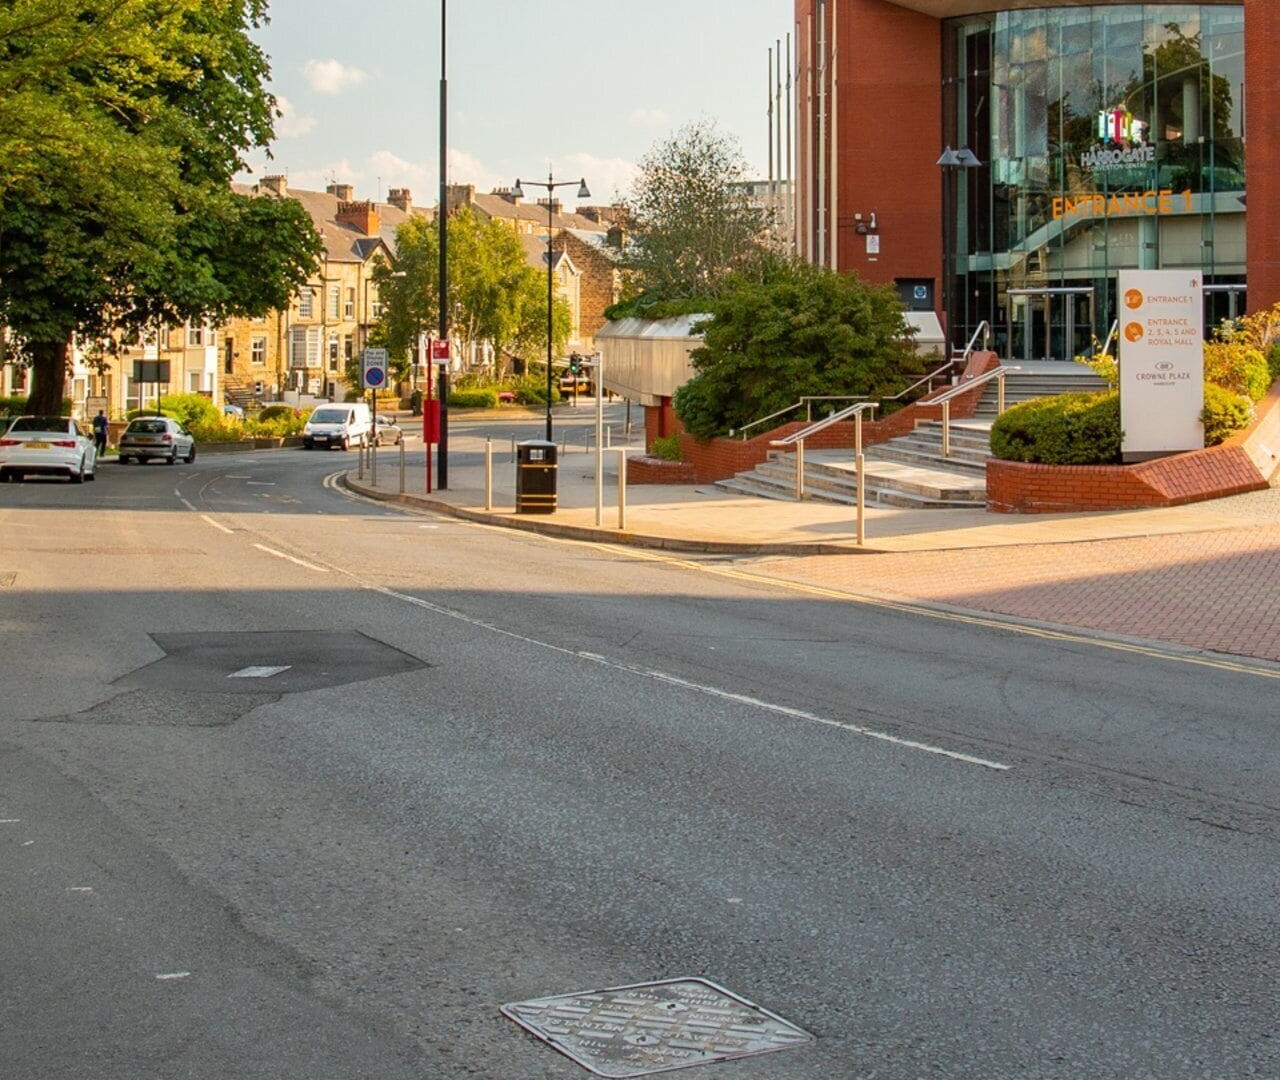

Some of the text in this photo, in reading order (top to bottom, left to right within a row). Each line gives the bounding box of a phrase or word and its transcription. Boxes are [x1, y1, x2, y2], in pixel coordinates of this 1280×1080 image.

[1081, 146, 1155, 167] HARROGATE
[1052, 189, 1192, 219] ENTRANCE 1
[1147, 296, 1188, 304] ENTRANCE
[1181, 328, 1197, 336] AND
[1136, 372, 1191, 381] CROWNE PLAZA
[551, 1018, 625, 1032] STANTON
